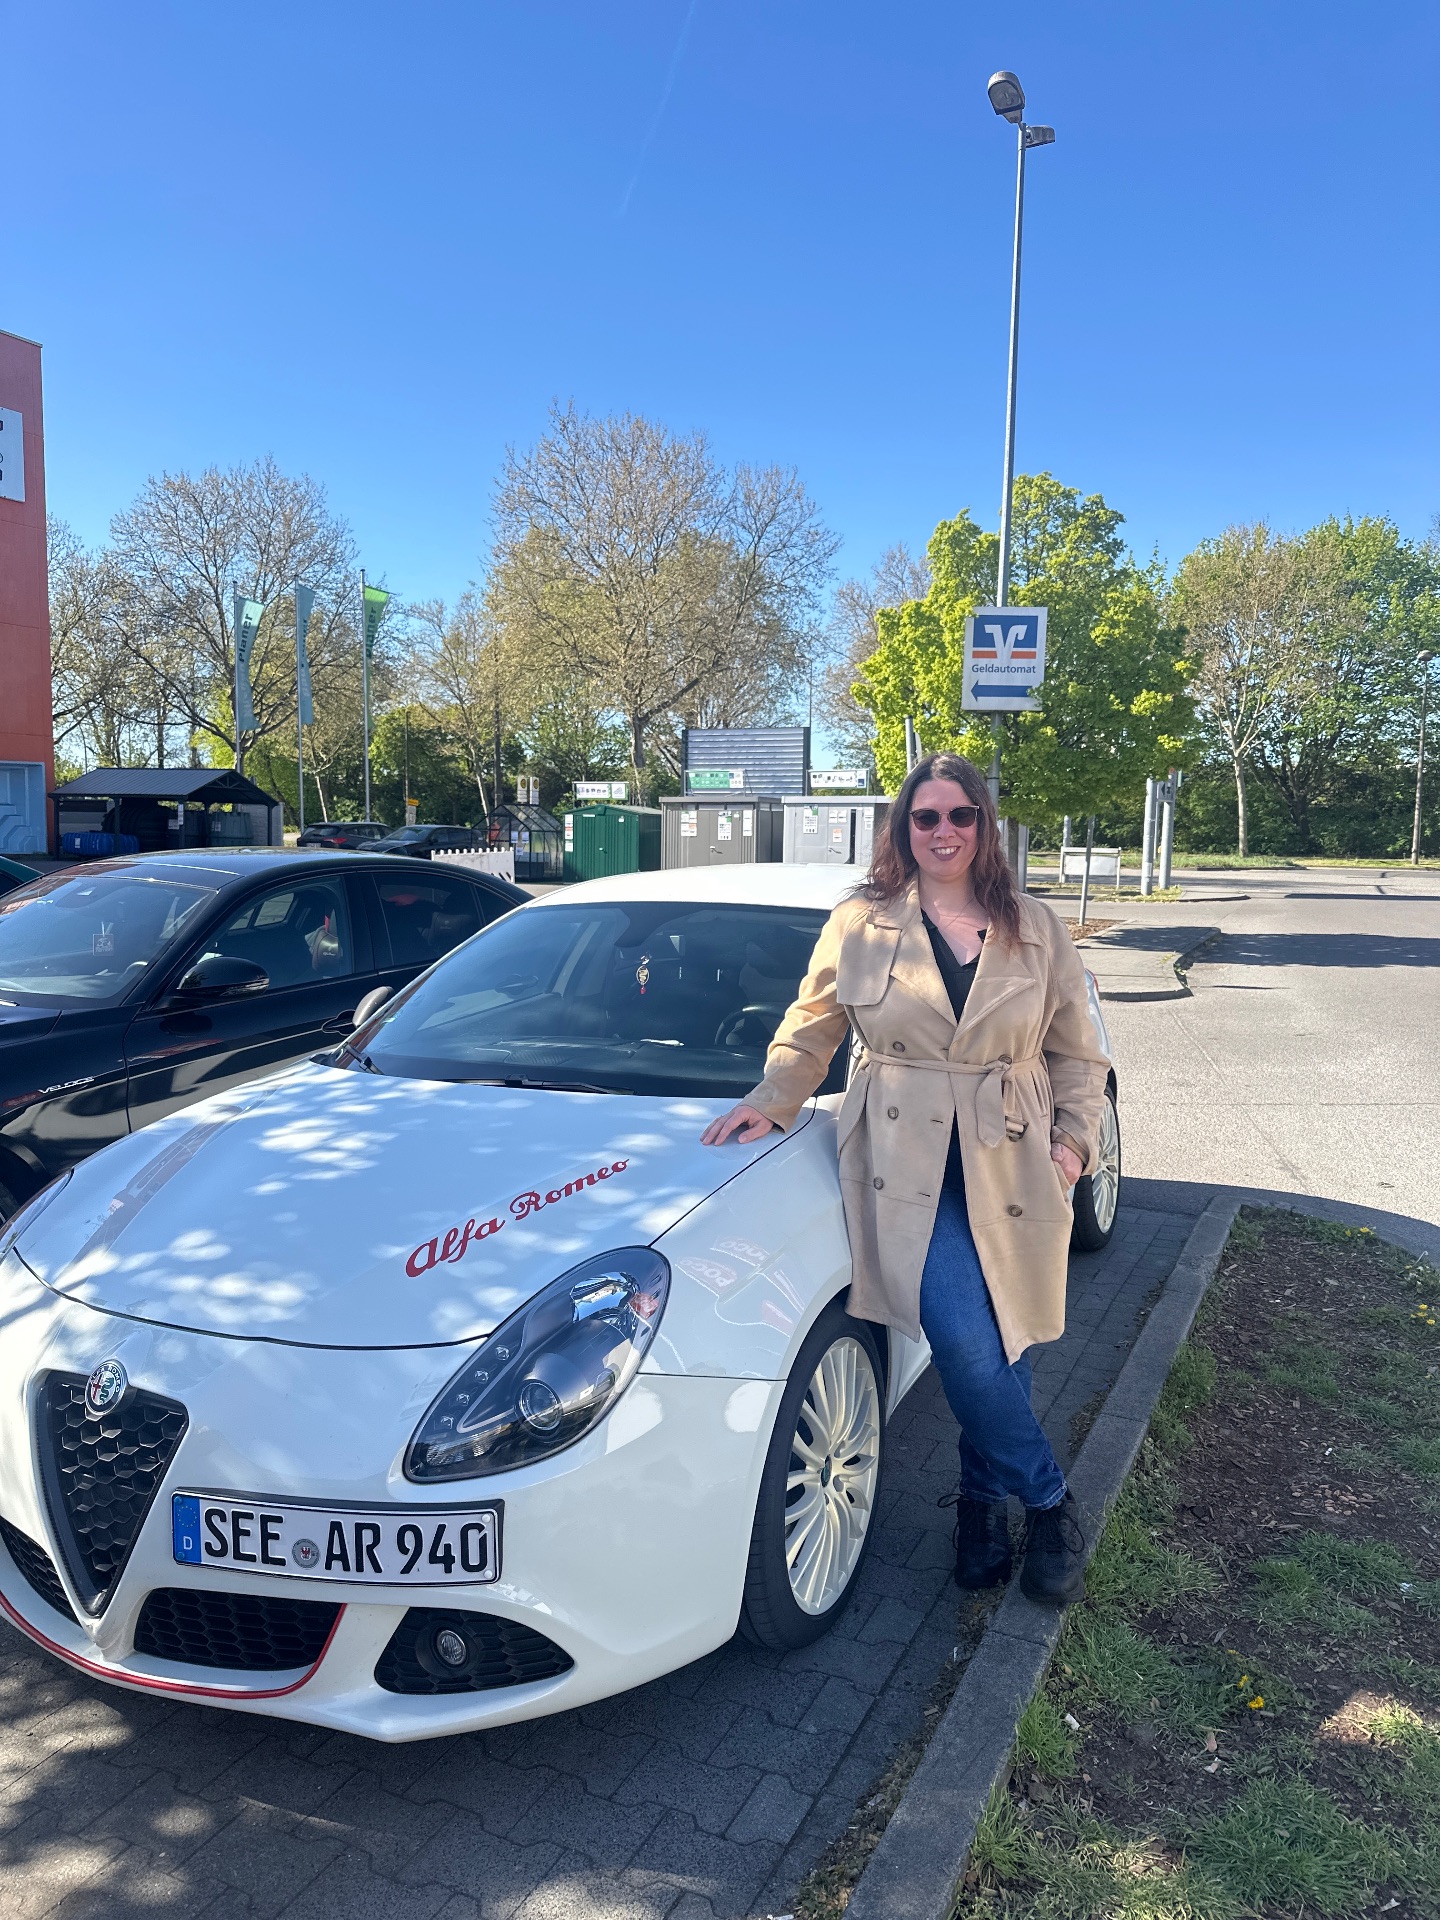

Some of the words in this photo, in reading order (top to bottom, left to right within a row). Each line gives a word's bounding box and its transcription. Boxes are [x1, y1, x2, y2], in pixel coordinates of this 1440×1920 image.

[239, 613, 253, 663] Planer
[971, 664, 1036, 674] Geldautomat
[38, 1076, 95, 1094] VELOCE
[405, 1218, 506, 1278] Alfa
[509, 1158, 630, 1221] Romeo
[183, 1535, 193, 1550] D
[204, 1507, 287, 1567] SEE
[324, 1520, 383, 1574] AR
[396, 1522, 489, 1575] 940
